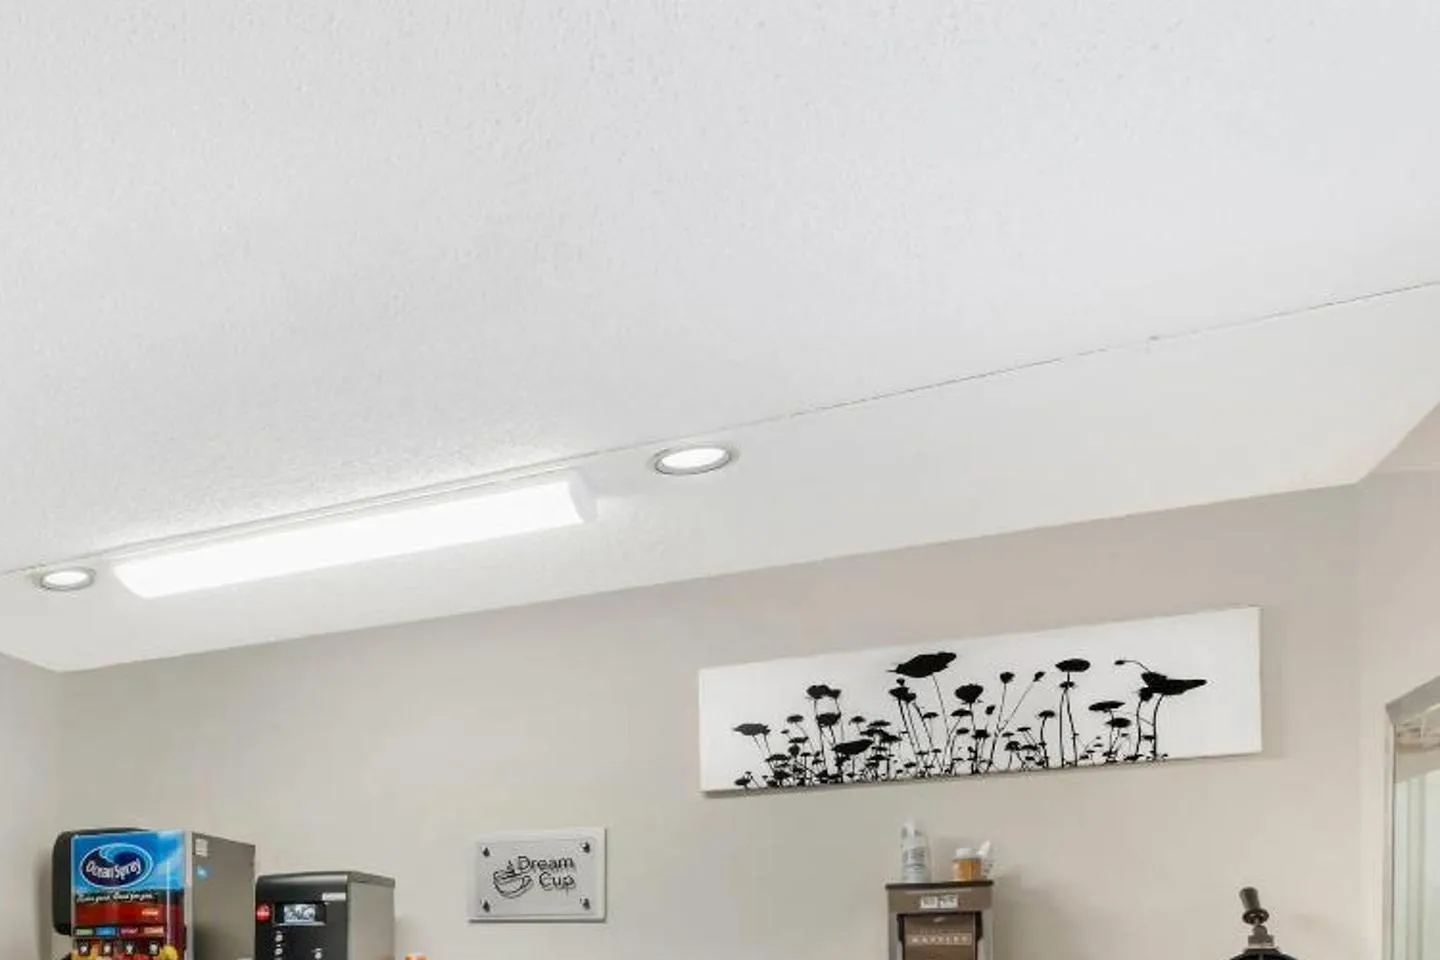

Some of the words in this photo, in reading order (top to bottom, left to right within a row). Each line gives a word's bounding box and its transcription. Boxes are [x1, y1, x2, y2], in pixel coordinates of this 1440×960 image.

[86, 860, 113, 879] Ocean
[114, 858, 141, 880] Spray
[517, 855, 574, 871] Dream
[539, 871, 575, 892] Cup
